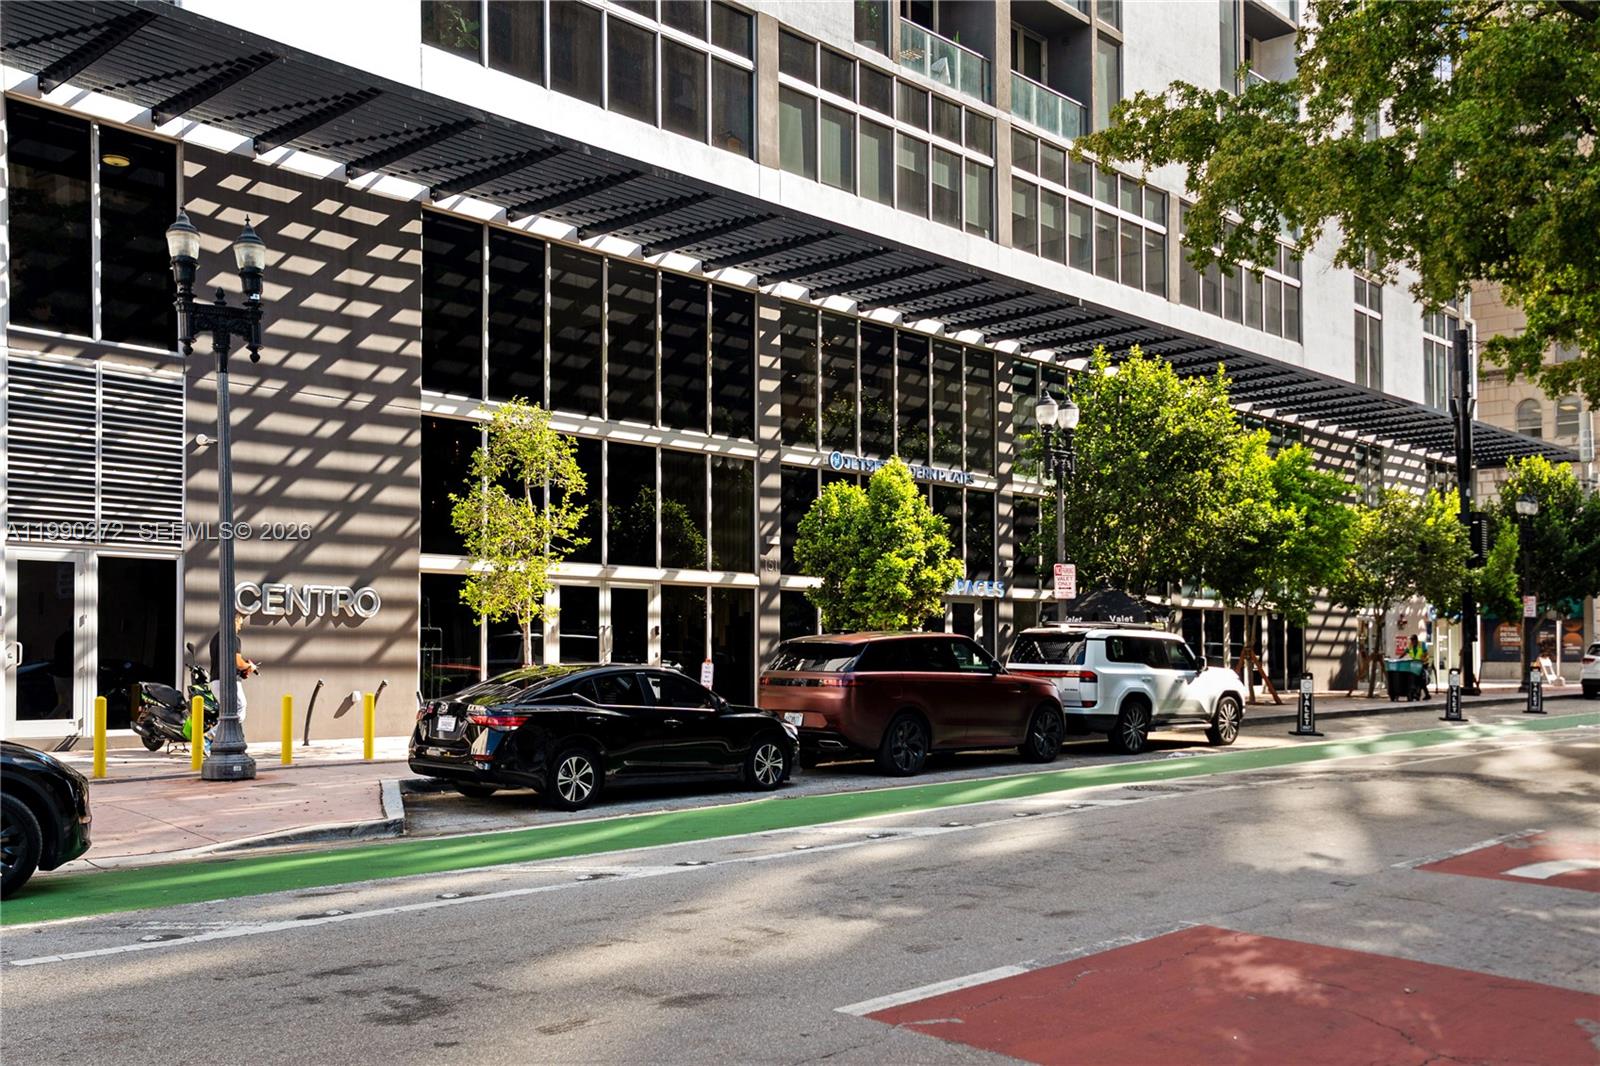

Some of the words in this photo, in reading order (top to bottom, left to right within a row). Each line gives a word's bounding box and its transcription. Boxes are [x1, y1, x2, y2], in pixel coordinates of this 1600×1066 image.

[843, 456, 886, 473] JETSE
[953, 578, 1005, 598] PACES
[234, 581, 382, 617] CENTRO
[1108, 615, 1134, 623] Valet
[1303, 693, 1311, 726] VALET
